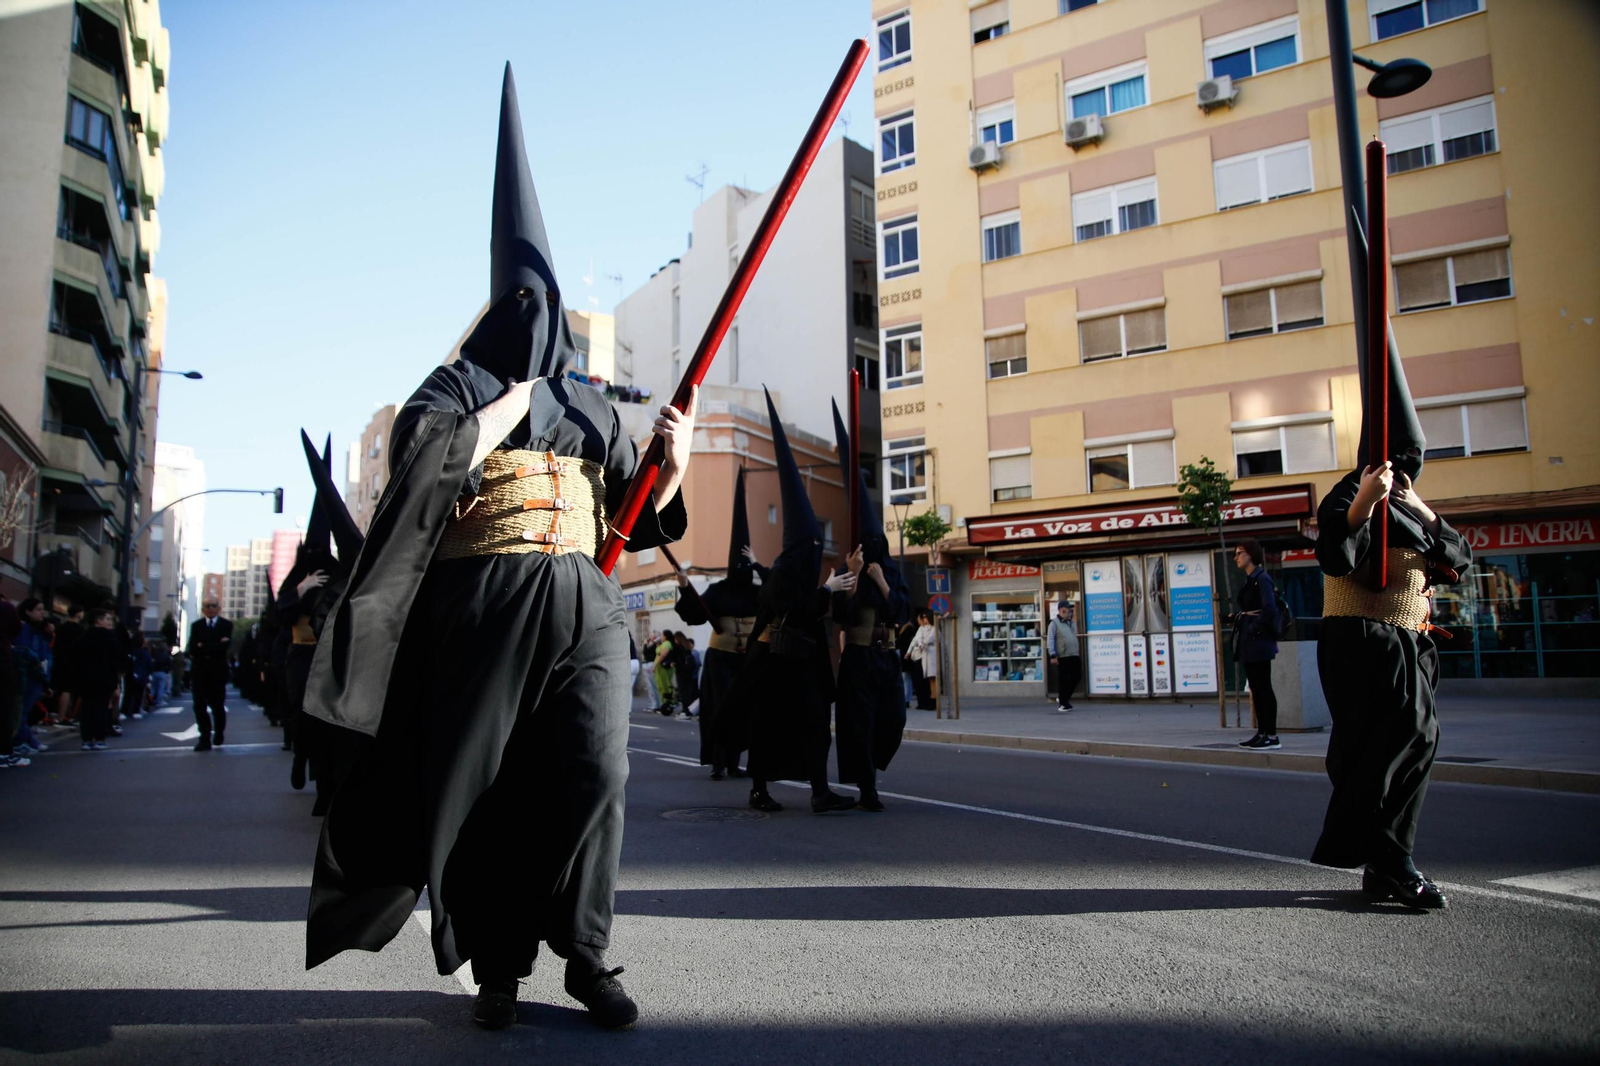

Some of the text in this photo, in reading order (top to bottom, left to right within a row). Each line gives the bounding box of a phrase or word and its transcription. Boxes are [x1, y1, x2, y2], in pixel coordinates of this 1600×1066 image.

[1004, 504, 1263, 539] La Voz de Almría
[1499, 519, 1595, 546] LENCERIA
[973, 565, 1038, 580] JUGUETES
